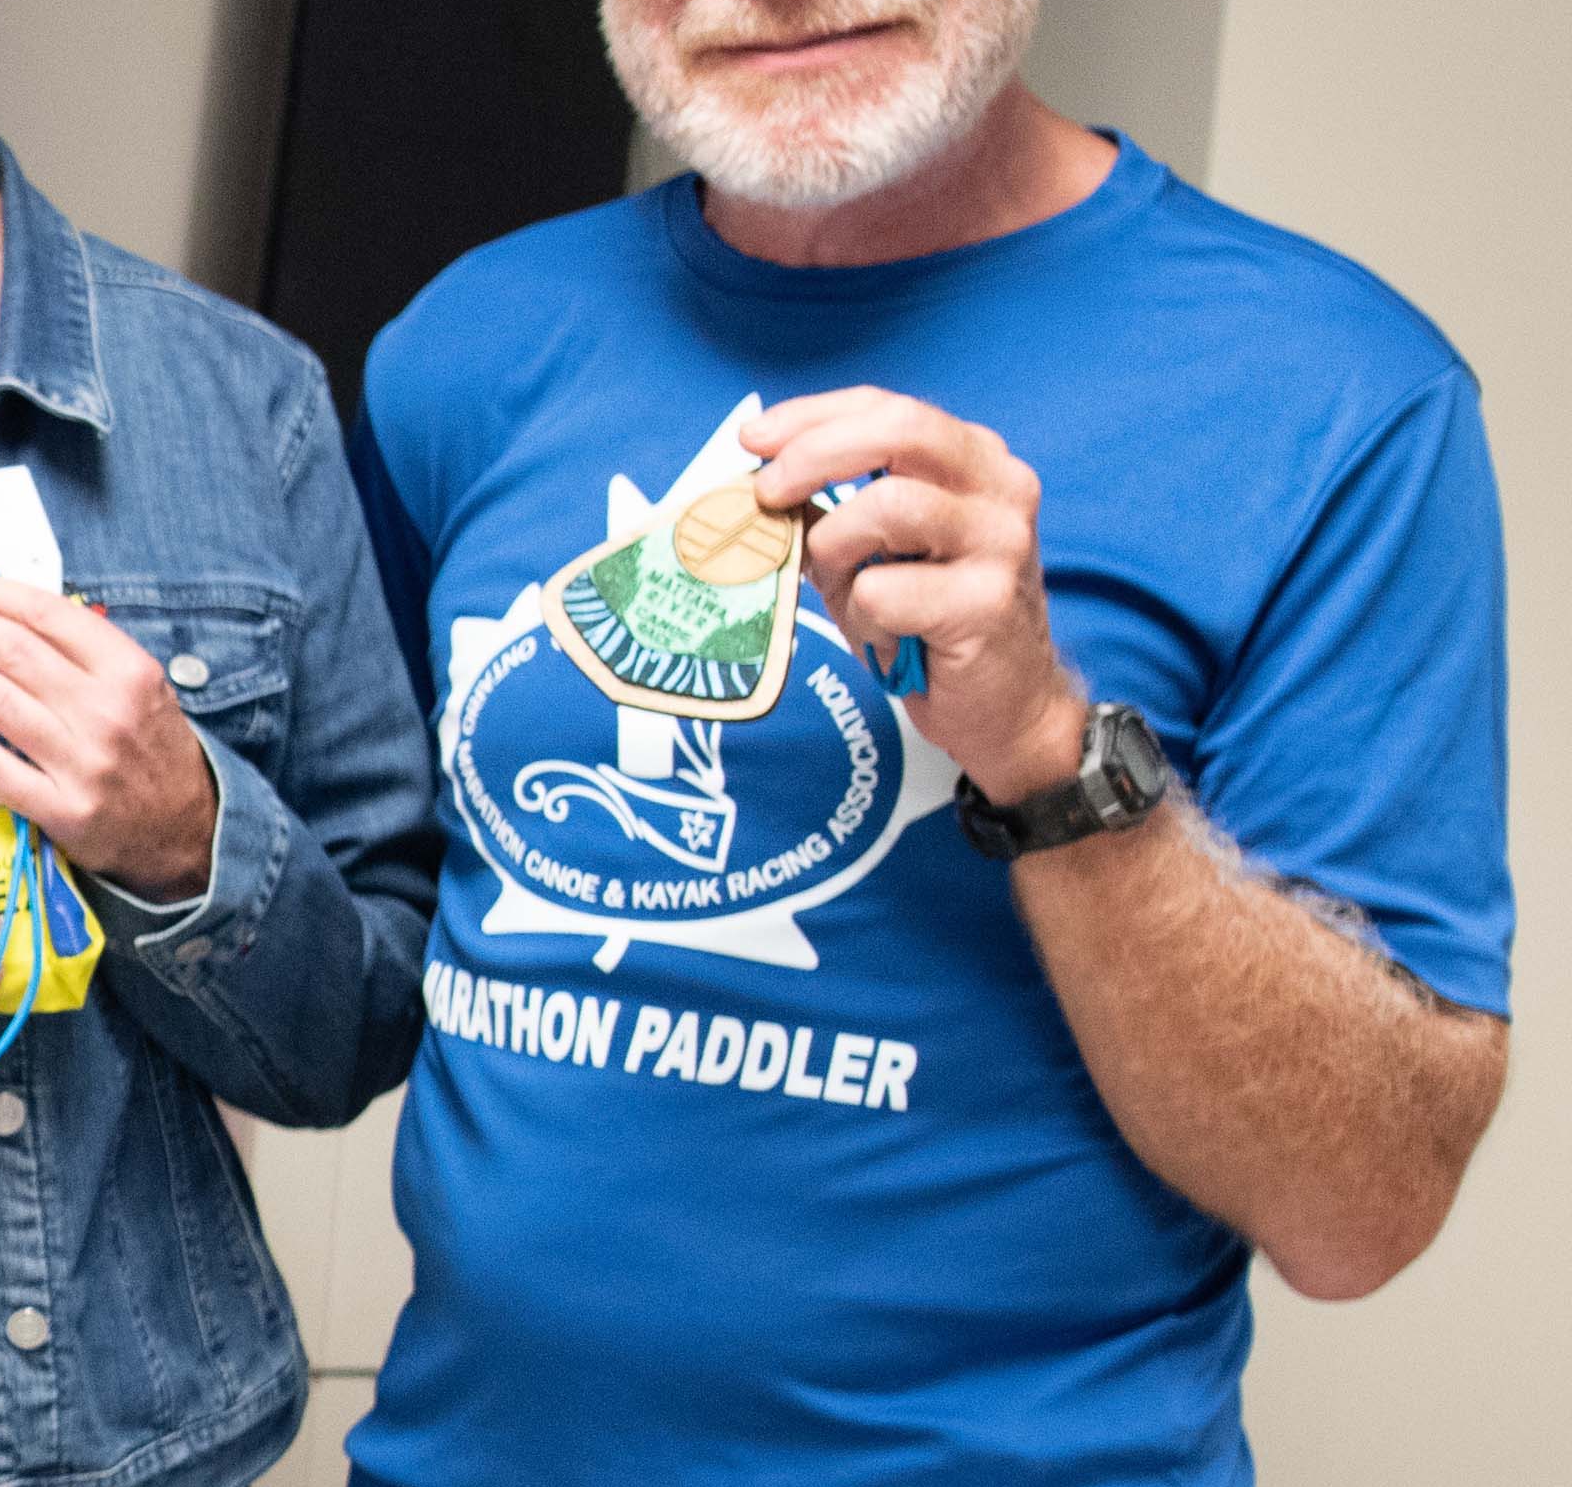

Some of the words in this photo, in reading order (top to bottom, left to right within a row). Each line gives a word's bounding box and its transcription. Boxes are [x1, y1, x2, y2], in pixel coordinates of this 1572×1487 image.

[462, 636, 537, 736] ONTARIO
[806, 664, 879, 845] ASSOCIATION
[459, 739, 526, 865] MARATHON
[525, 851, 598, 903] CANOE
[603, 879, 626, 909] &
[632, 876, 721, 910] KAYAK
[727, 832, 831, 901] RACING
[422, 959, 621, 1070] MARATHON
[623, 1004, 919, 1112] PADDLER
